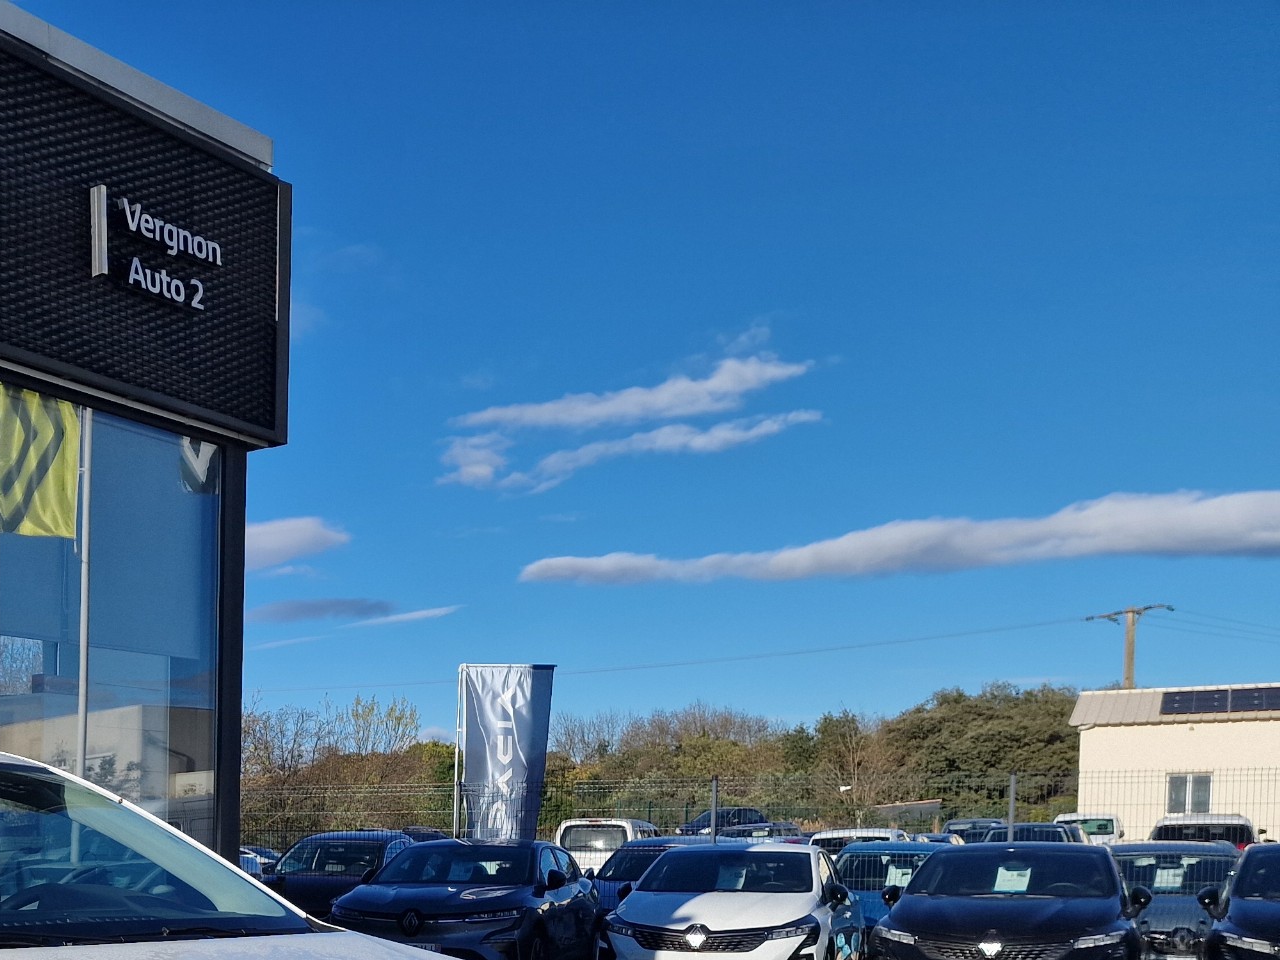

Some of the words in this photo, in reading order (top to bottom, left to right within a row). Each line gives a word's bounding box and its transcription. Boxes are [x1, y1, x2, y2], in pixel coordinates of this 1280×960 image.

[118, 197, 222, 266] Vergnon
[128, 257, 185, 303] Auto
[190, 278, 205, 310] 2
